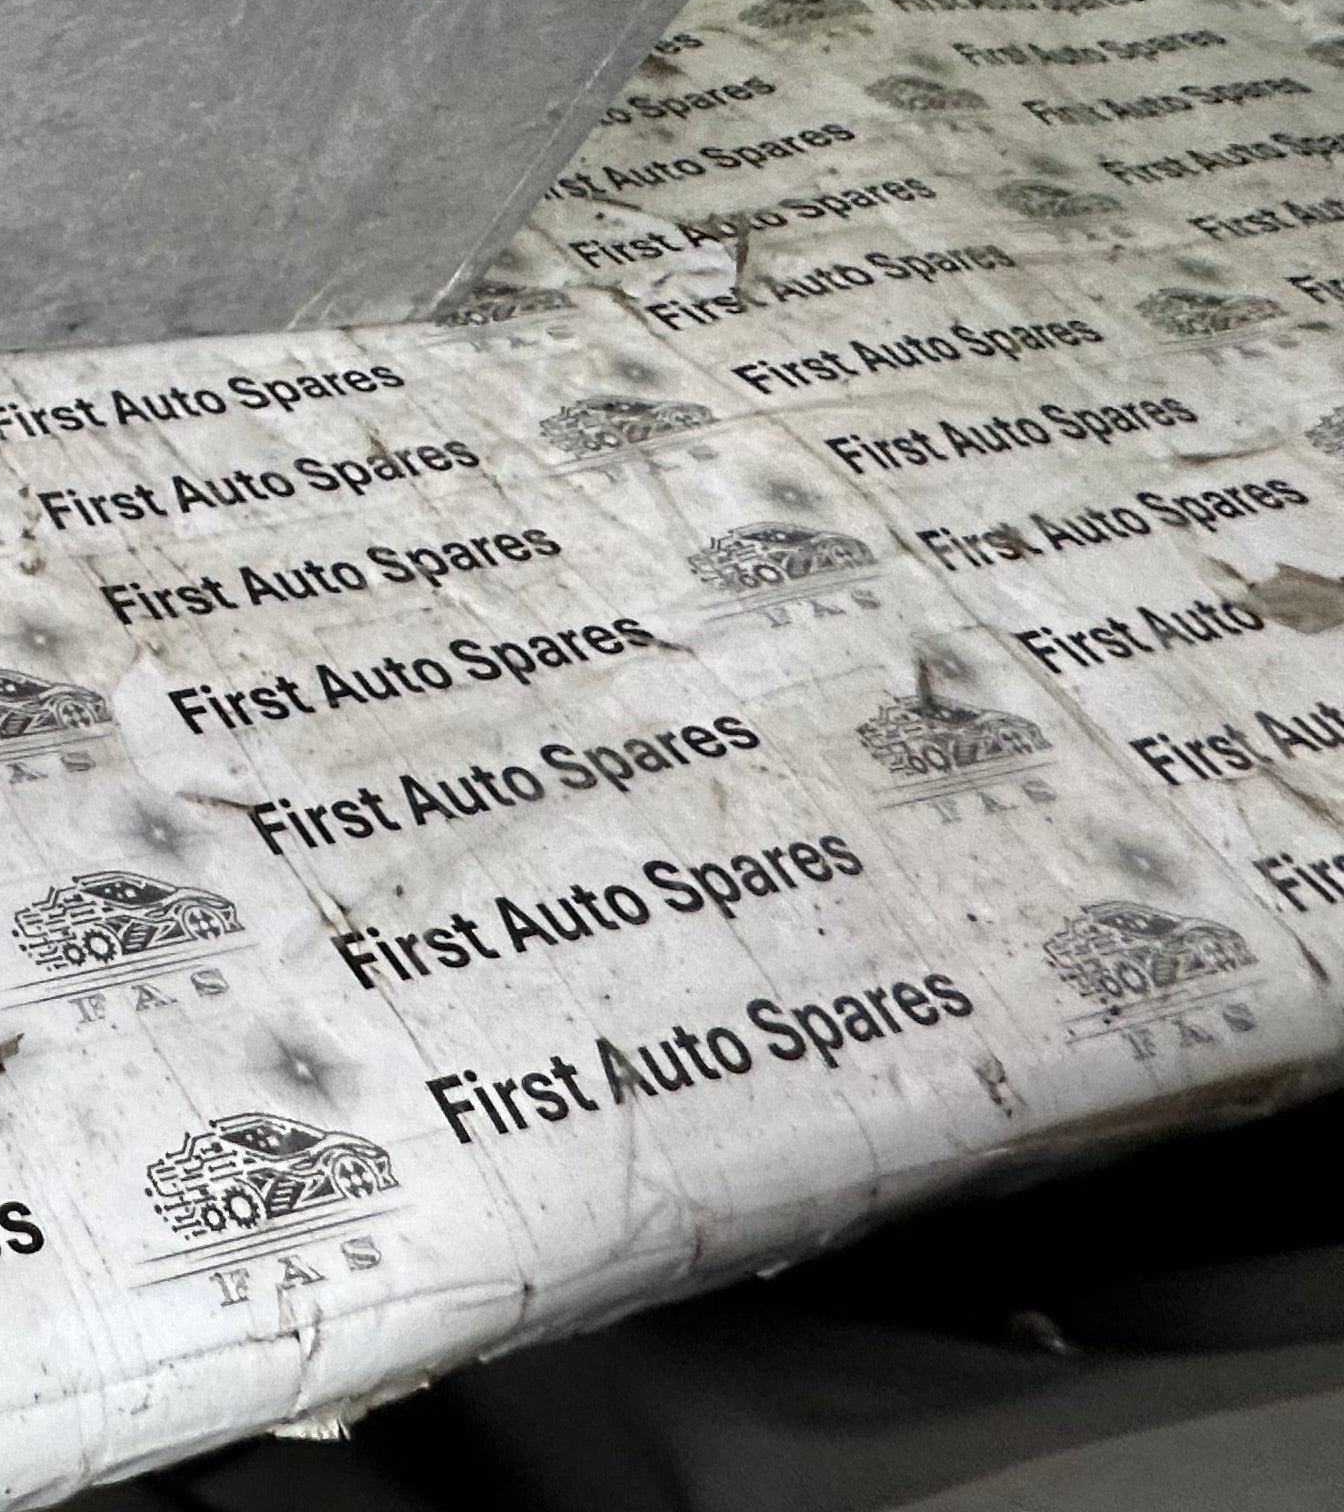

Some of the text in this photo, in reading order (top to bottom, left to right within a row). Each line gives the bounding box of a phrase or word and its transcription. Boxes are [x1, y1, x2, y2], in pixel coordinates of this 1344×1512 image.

[629, 75, 778, 121] Spares
[605, 122, 857, 192] Auto Spares
[1185, 141, 1288, 174] Auto
[568, 231, 684, 269] First
[778, 175, 938, 221] Spares
[645, 243, 1016, 332] First Auto Spares
[114, 386, 227, 426] Auto
[227, 365, 405, 413] Spares
[733, 318, 1104, 396] First Auto Spares
[826, 396, 1199, 476] First Auto Spares
[37, 437, 481, 531] First Auto Spares
[916, 478, 1310, 572] First Auto Spares
[100, 526, 562, 625] First Auto Spares
[168, 618, 655, 736] First Auto Spares
[1015, 598, 1265, 675] First Auto
[250, 714, 761, 855] First Auto Spares
[1128, 700, 1344, 786] First Aut
[330, 834, 865, 991] First Auto Spares
[424, 972, 975, 1145] First Auto Spares
